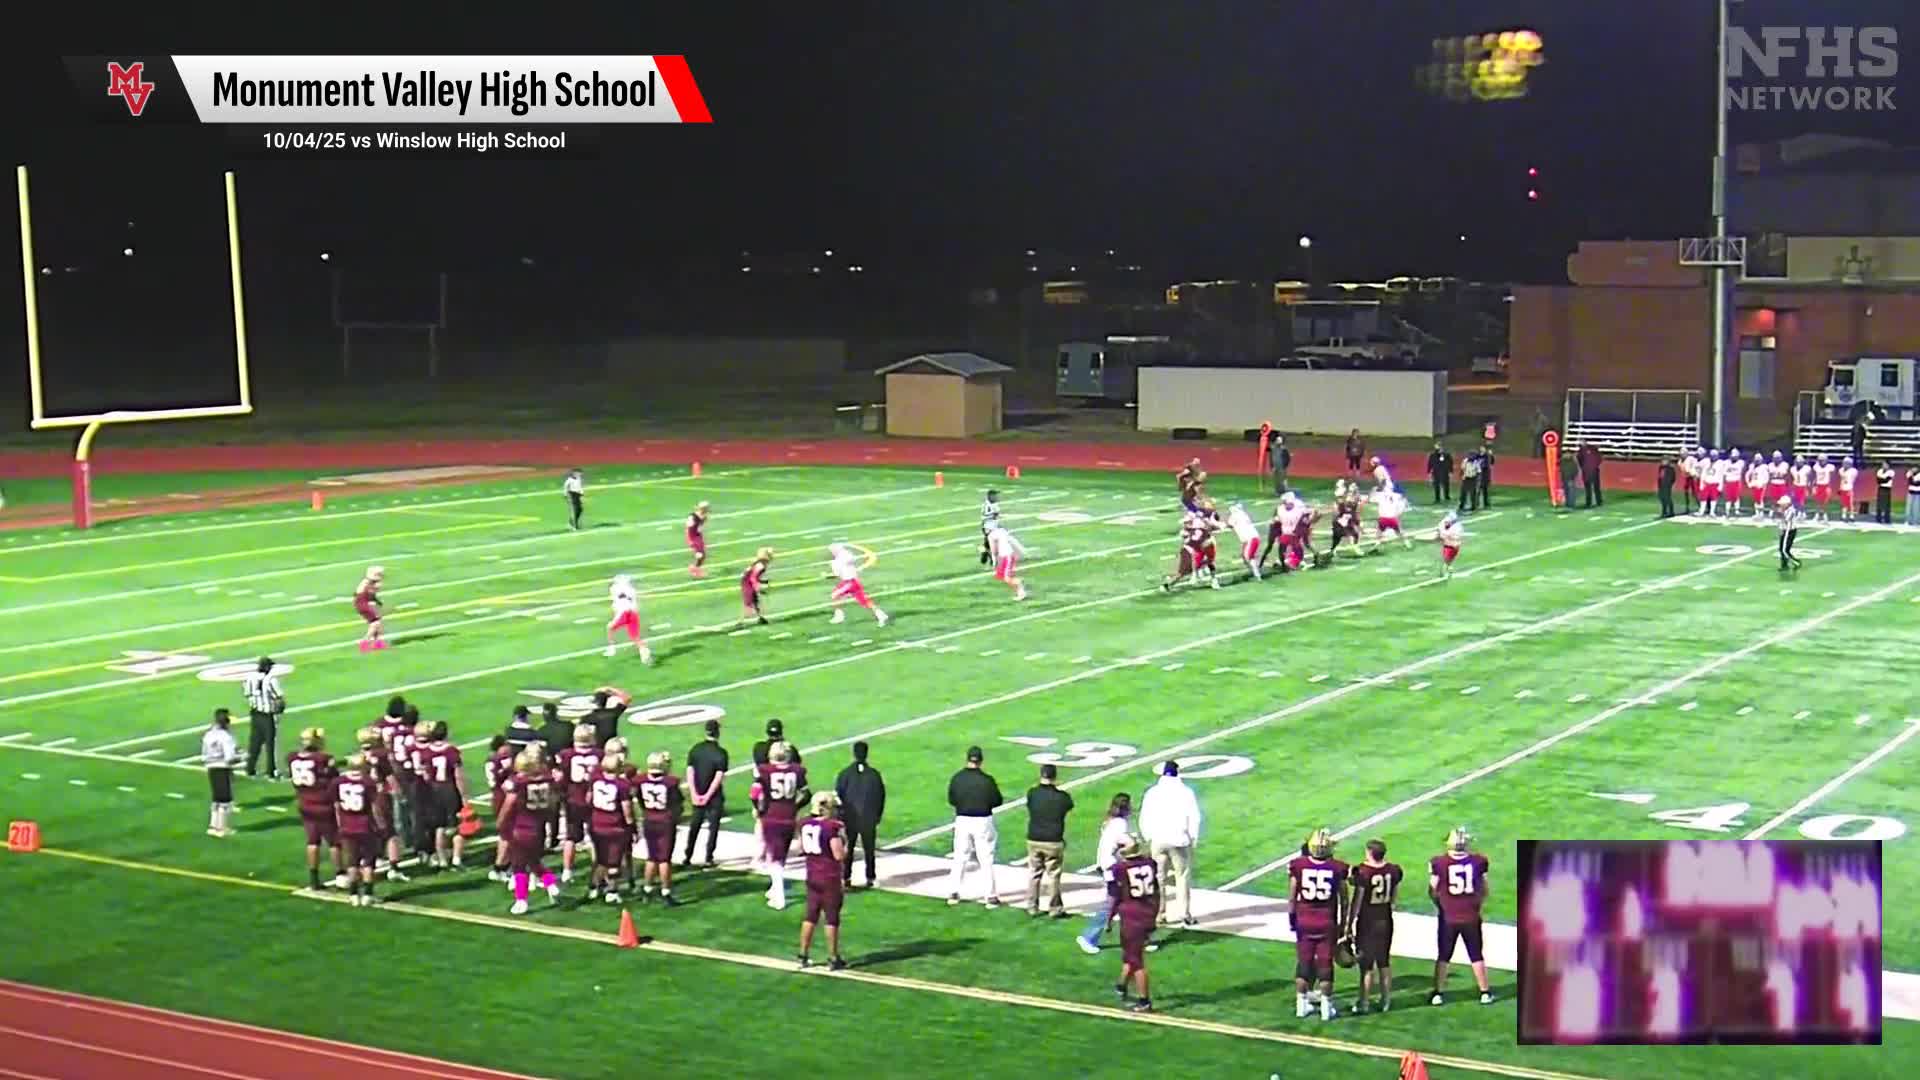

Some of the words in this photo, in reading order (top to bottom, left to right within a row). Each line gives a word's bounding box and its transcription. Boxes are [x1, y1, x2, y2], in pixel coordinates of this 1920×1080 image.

[1026, 741, 1255, 778] 30
[640, 782, 667, 811] 53
[769, 771, 797, 800] 50
[10, 825, 31, 846] 20
[1647, 802, 1907, 840] 40
[1126, 864, 1155, 898] 52
[1301, 868, 1334, 901] 55
[1370, 872, 1393, 905] 21
[1447, 862, 1475, 896] 51
